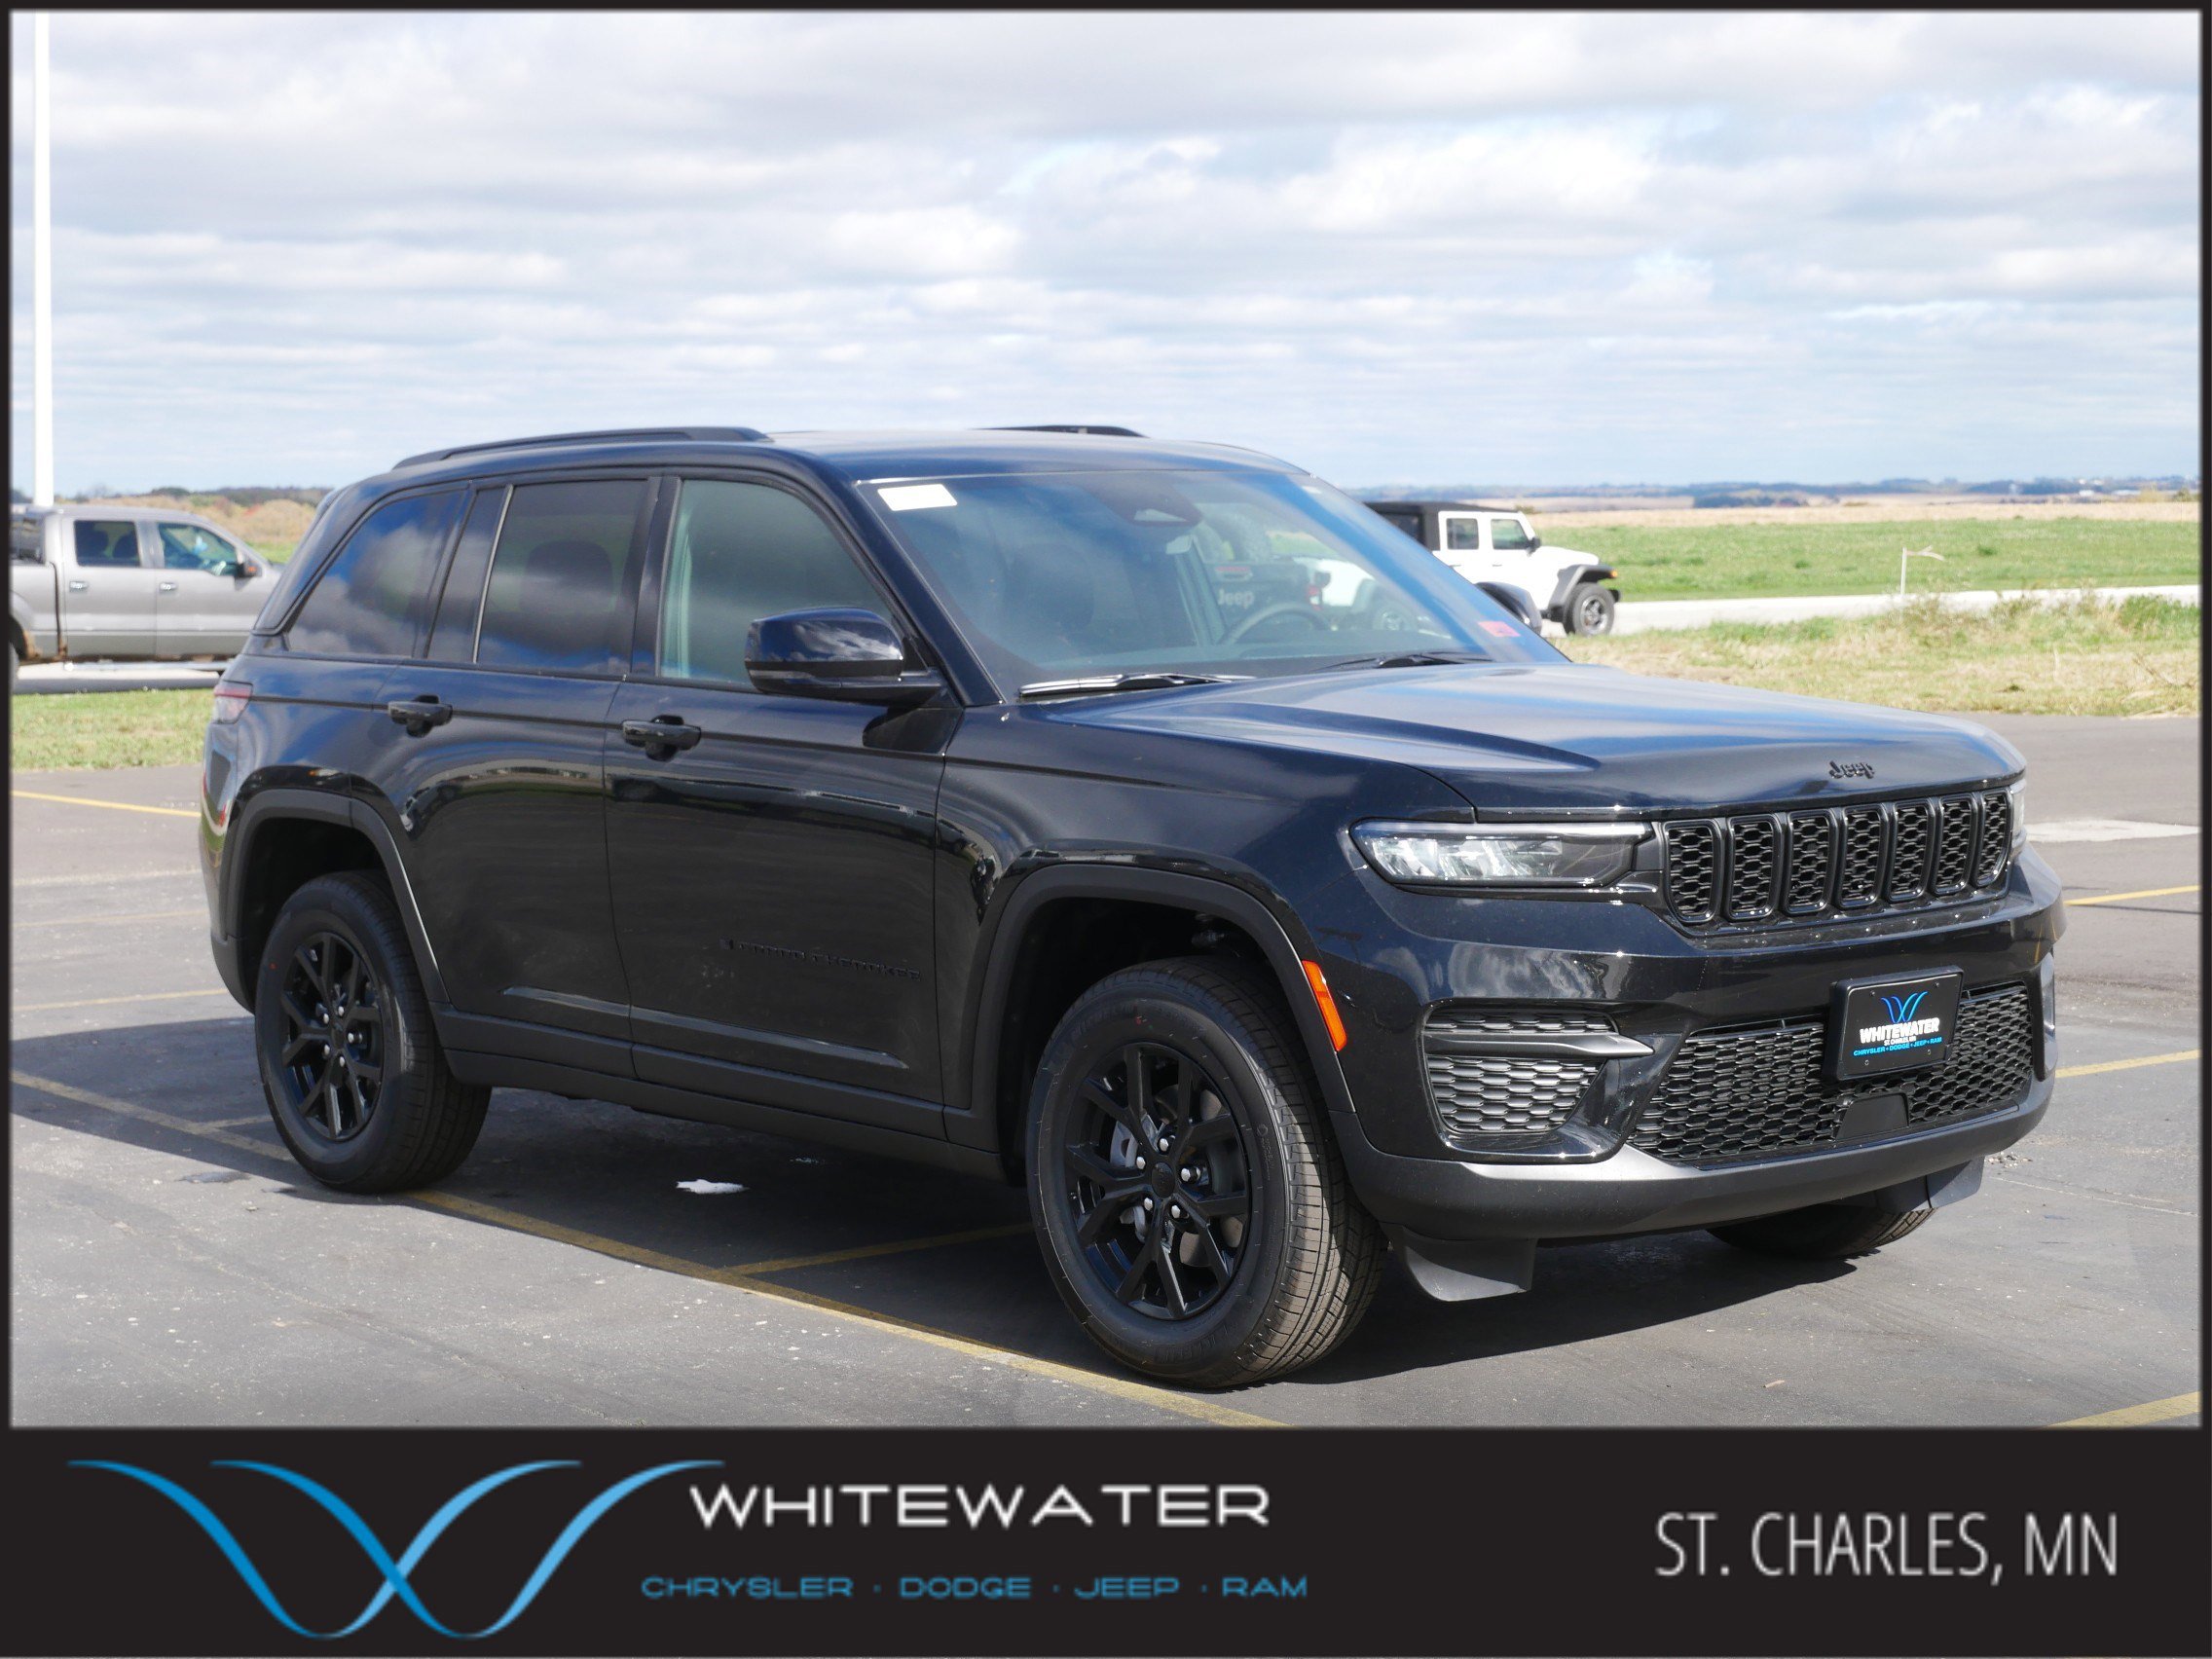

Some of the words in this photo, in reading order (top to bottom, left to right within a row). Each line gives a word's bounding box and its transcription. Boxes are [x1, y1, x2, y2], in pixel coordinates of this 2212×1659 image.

[1218, 588, 1255, 609] Jeep
[1829, 760, 1875, 780] Jeep
[1860, 1017, 1940, 1044] WHITEWATER
[1853, 1046, 1886, 1056] CHRYSLER
[1889, 1042, 1910, 1051] DODGE
[1913, 1039, 1928, 1048] JEEP
